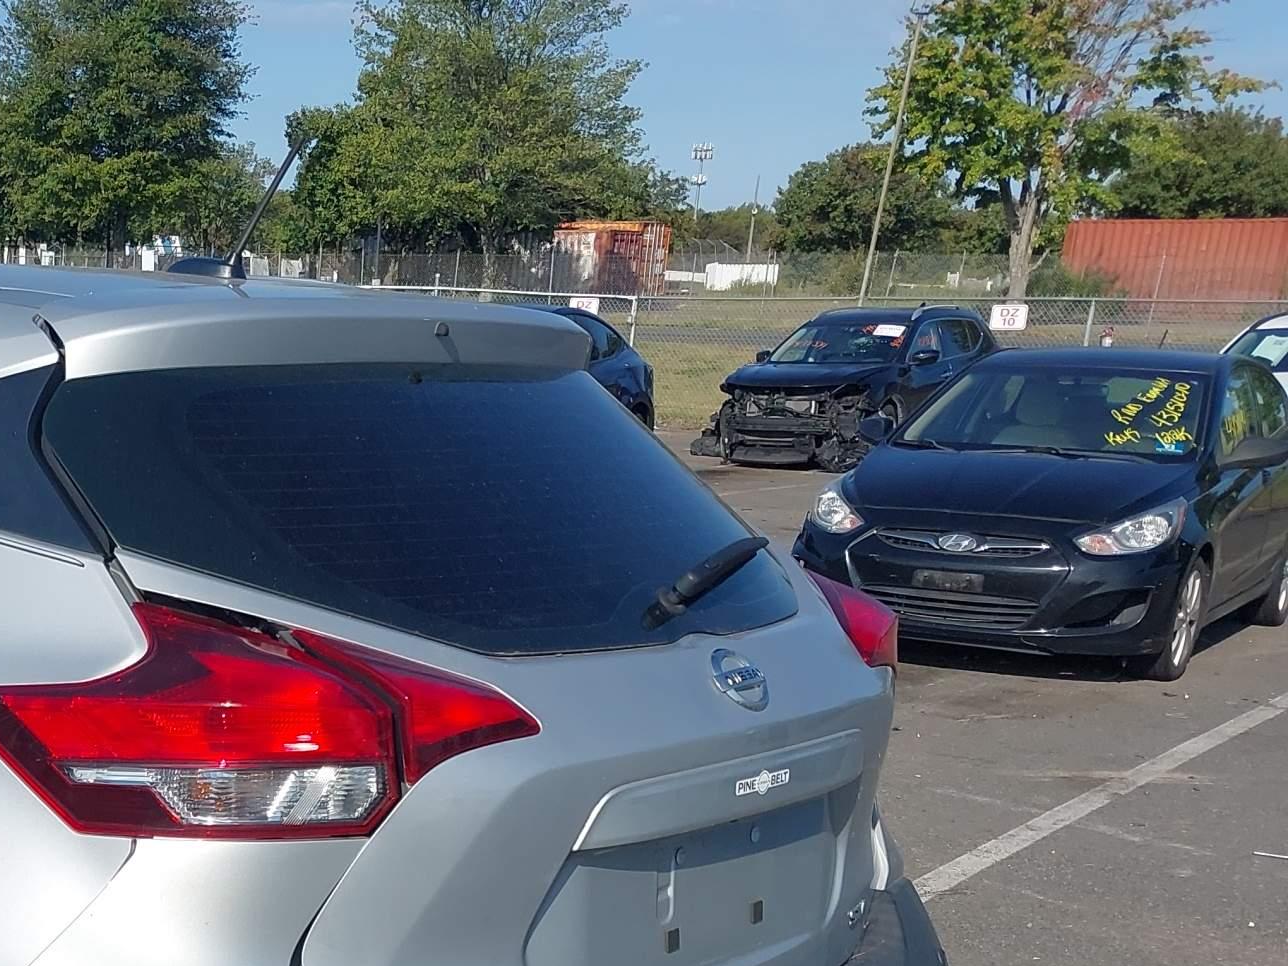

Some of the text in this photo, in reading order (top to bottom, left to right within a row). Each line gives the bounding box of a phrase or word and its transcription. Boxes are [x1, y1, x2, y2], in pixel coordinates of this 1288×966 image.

[577, 300, 592, 309] DZ
[1000, 308, 1020, 318] DZ
[1001, 317, 1016, 327] 10
[737, 770, 789, 794] PINE BELT
